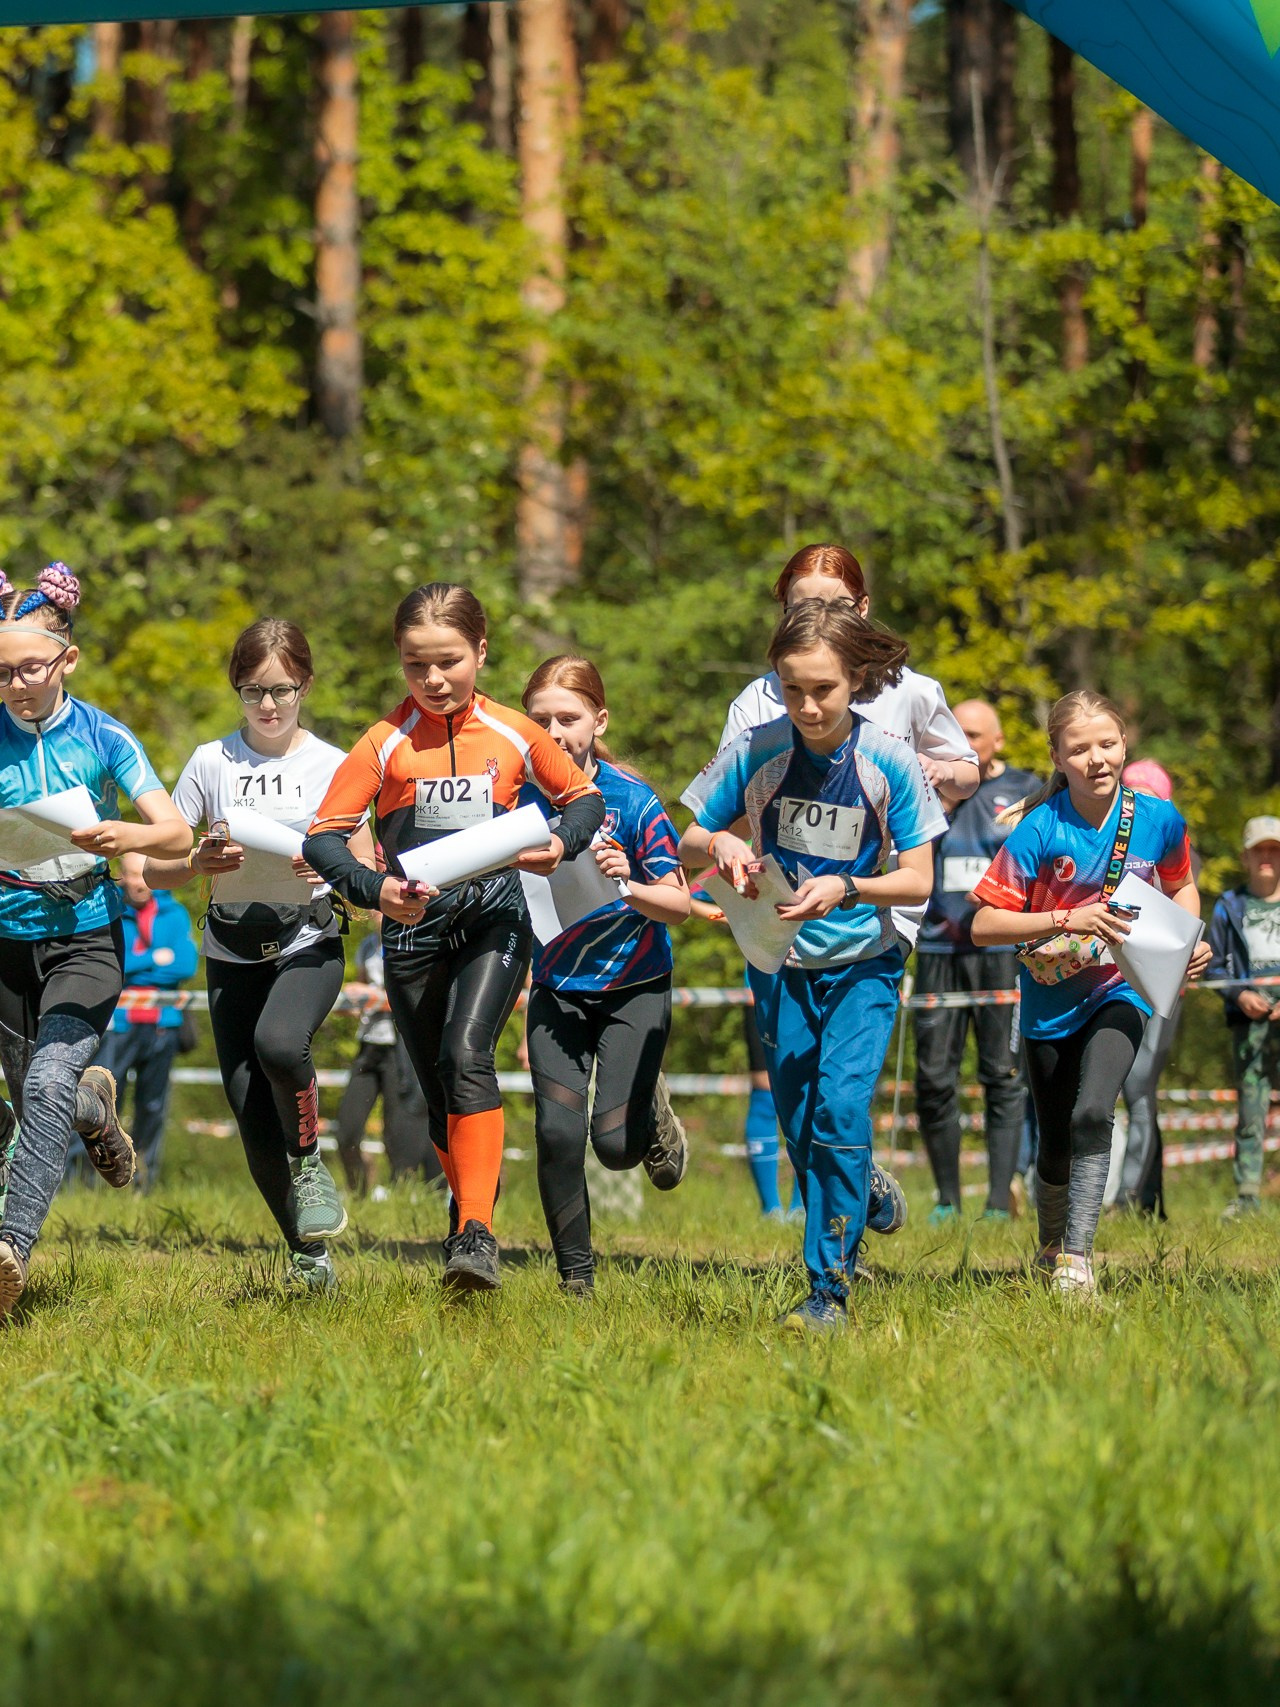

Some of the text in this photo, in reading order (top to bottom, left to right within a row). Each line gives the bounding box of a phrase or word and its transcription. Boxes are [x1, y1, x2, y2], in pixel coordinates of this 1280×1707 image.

[239, 774, 282, 796] 711
[295, 784, 302, 798] 1
[423, 778, 472, 803] 702
[233, 797, 255, 807] Ж12
[482, 788, 489, 803] 1
[415, 804, 440, 815] Ж12
[788, 800, 838, 831] 701
[777, 822, 803, 837] Ж12
[851, 822, 859, 837] 1
[1107, 841, 1127, 880] LOVE
[1118, 800, 1134, 837] LOVE
